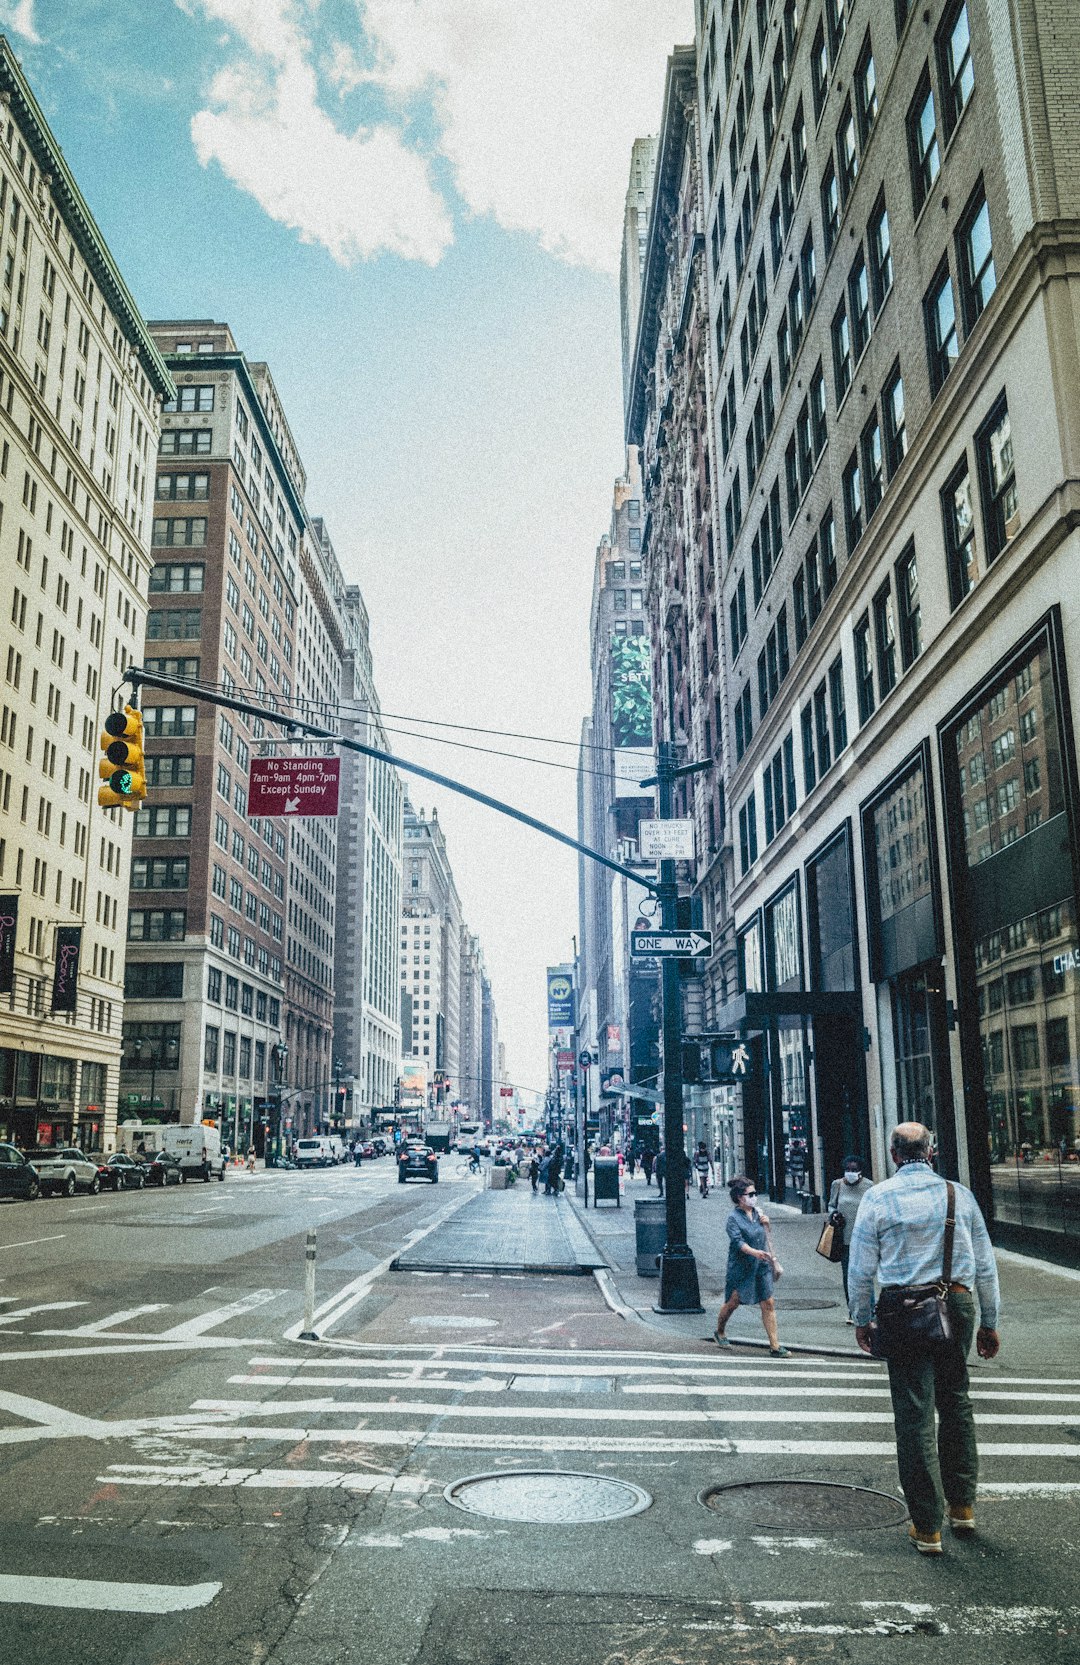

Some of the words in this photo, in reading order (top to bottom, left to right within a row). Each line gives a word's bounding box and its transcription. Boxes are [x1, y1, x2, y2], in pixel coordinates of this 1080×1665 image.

[267, 761, 279, 770] No
[282, 761, 323, 772] Standing
[252, 773, 291, 783] 7am-9am
[296, 773, 337, 784] 4pm-7pm
[261, 785, 291, 795] Except
[294, 784, 327, 795] Sunday
[638, 939, 662, 949] ONE
[675, 939, 701, 949] WAY
[553, 987, 568, 996] NY
